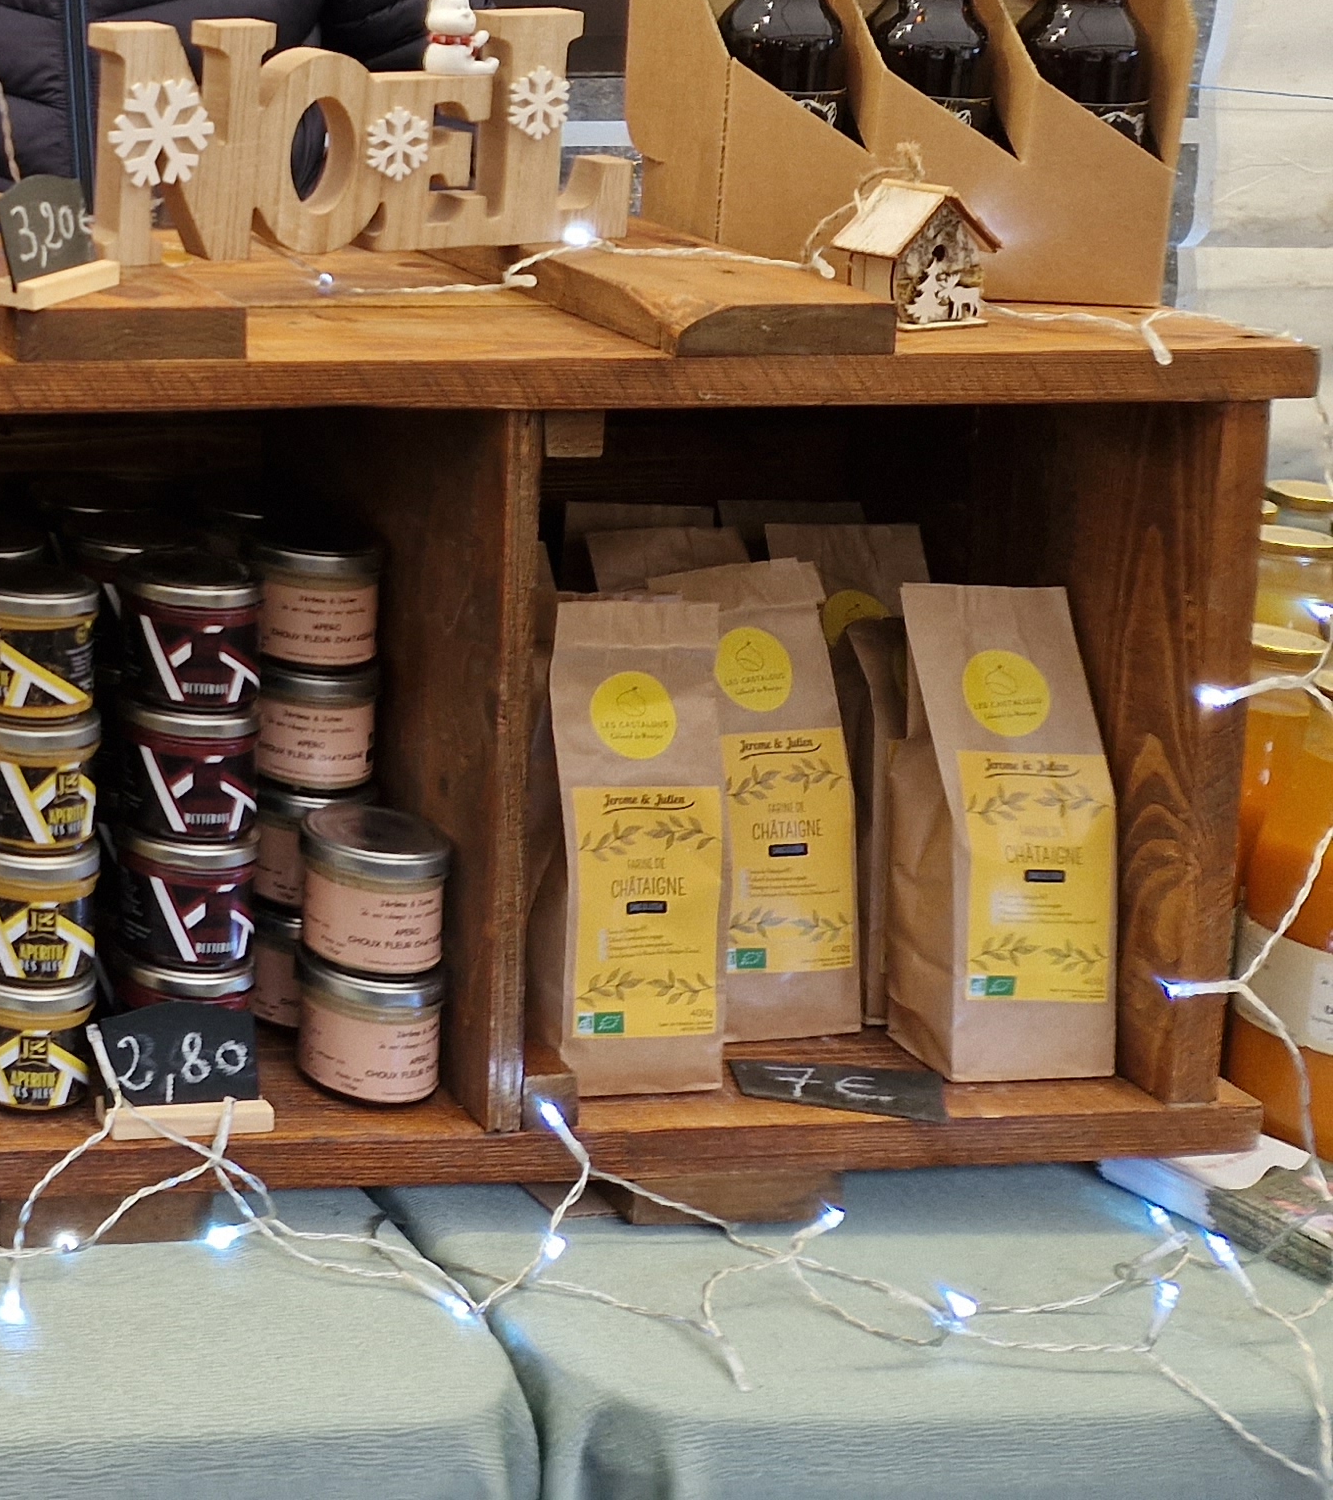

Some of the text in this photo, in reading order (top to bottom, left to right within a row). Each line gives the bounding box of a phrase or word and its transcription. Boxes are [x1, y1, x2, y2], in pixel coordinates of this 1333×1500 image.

[751, 818, 824, 841] CHÂTAIGNE
[610, 875, 687, 899] CHÂTAIGNE
[116, 1031, 250, 1104] 2,80
